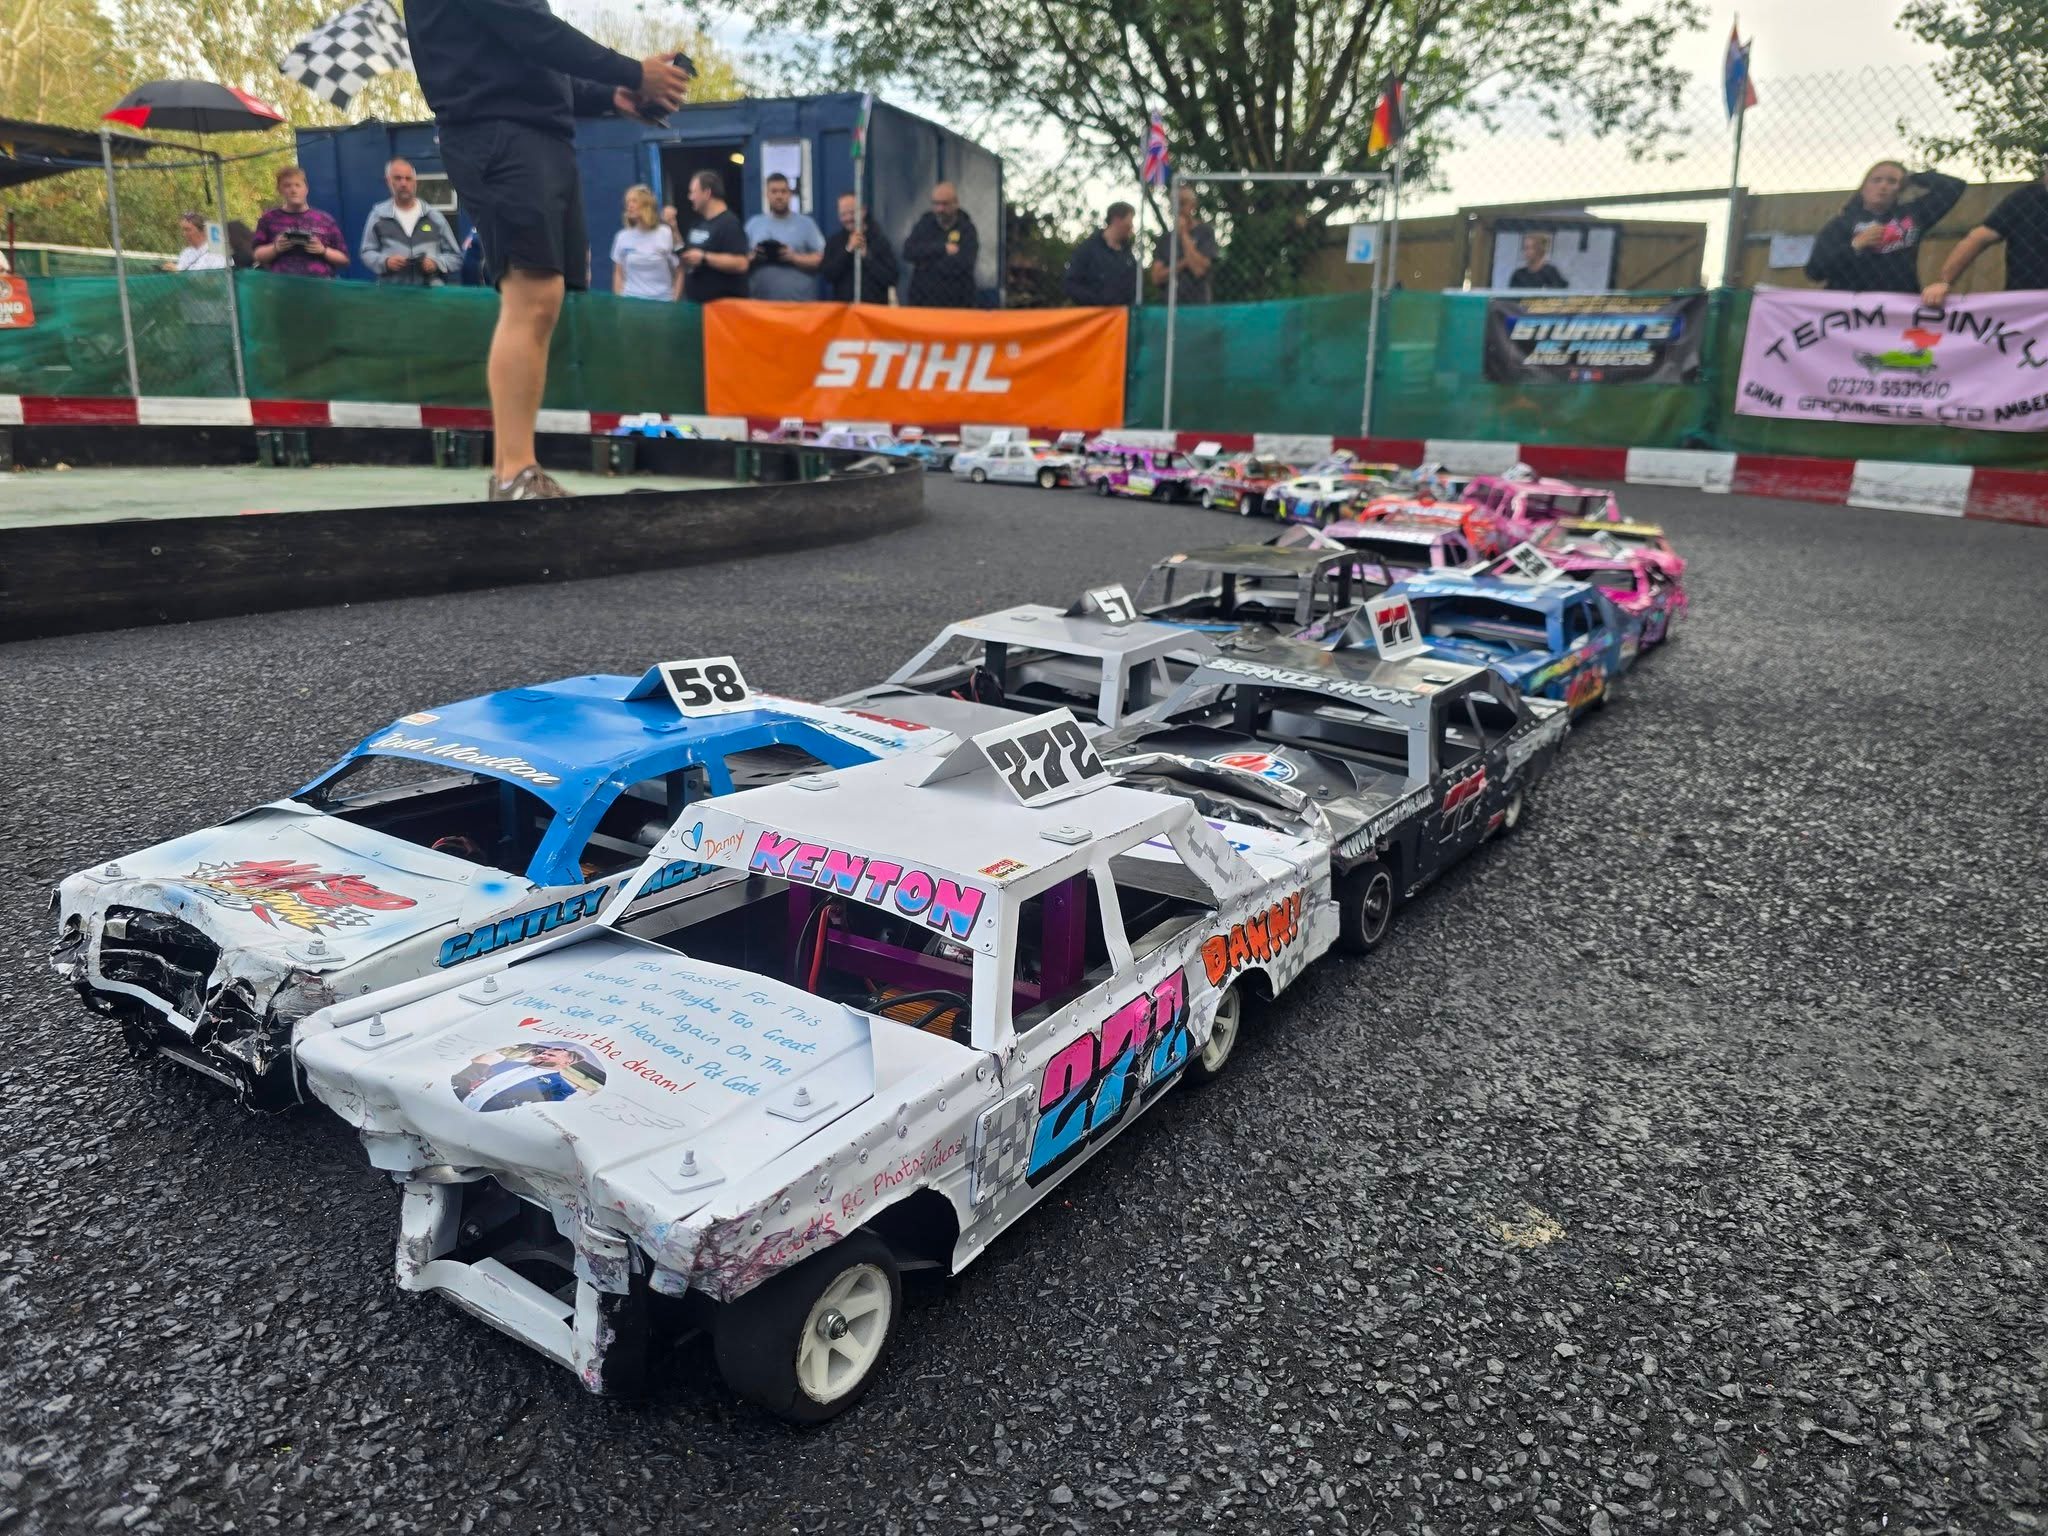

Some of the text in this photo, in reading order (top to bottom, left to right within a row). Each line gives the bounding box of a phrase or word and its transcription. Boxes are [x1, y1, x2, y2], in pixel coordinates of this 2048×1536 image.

[1764, 304, 1887, 363] TEAM
[813, 339, 1013, 394] STIHL
[1093, 588, 1137, 622] 57
[669, 664, 745, 706] 58
[1205, 657, 1425, 708] BERNIE HOOK
[369, 723, 562, 786] Josh Moulton
[986, 720, 1105, 800] 272
[704, 829, 745, 860] Danny
[749, 831, 987, 940] KENTON
[439, 885, 610, 969] CANTLEY
[633, 961, 662, 973] Too
[742, 991, 776, 1007] For
[780, 1005, 822, 1027] This
[642, 983, 662, 992] Or
[666, 988, 722, 1014] Maybe
[727, 1009, 753, 1029] Too
[512, 996, 557, 1011] Other
[560, 1004, 595, 1020] Side
[597, 1014, 624, 1027] Of
[622, 1021, 695, 1065] Heaven's
[694, 1061, 728, 1080] Pit
[589, 1036, 622, 1060] the
[621, 1057, 697, 1095] dream!
[600, 994, 628, 1006] See
[637, 1001, 664, 1016] You
[666, 1014, 721, 1046] Again
[726, 1044, 752, 1062] On
[759, 1055, 792, 1076] The
[1026, 965, 1197, 1188] 272
[841, 1188, 866, 1217] RC
[873, 1151, 928, 1196] Photos
